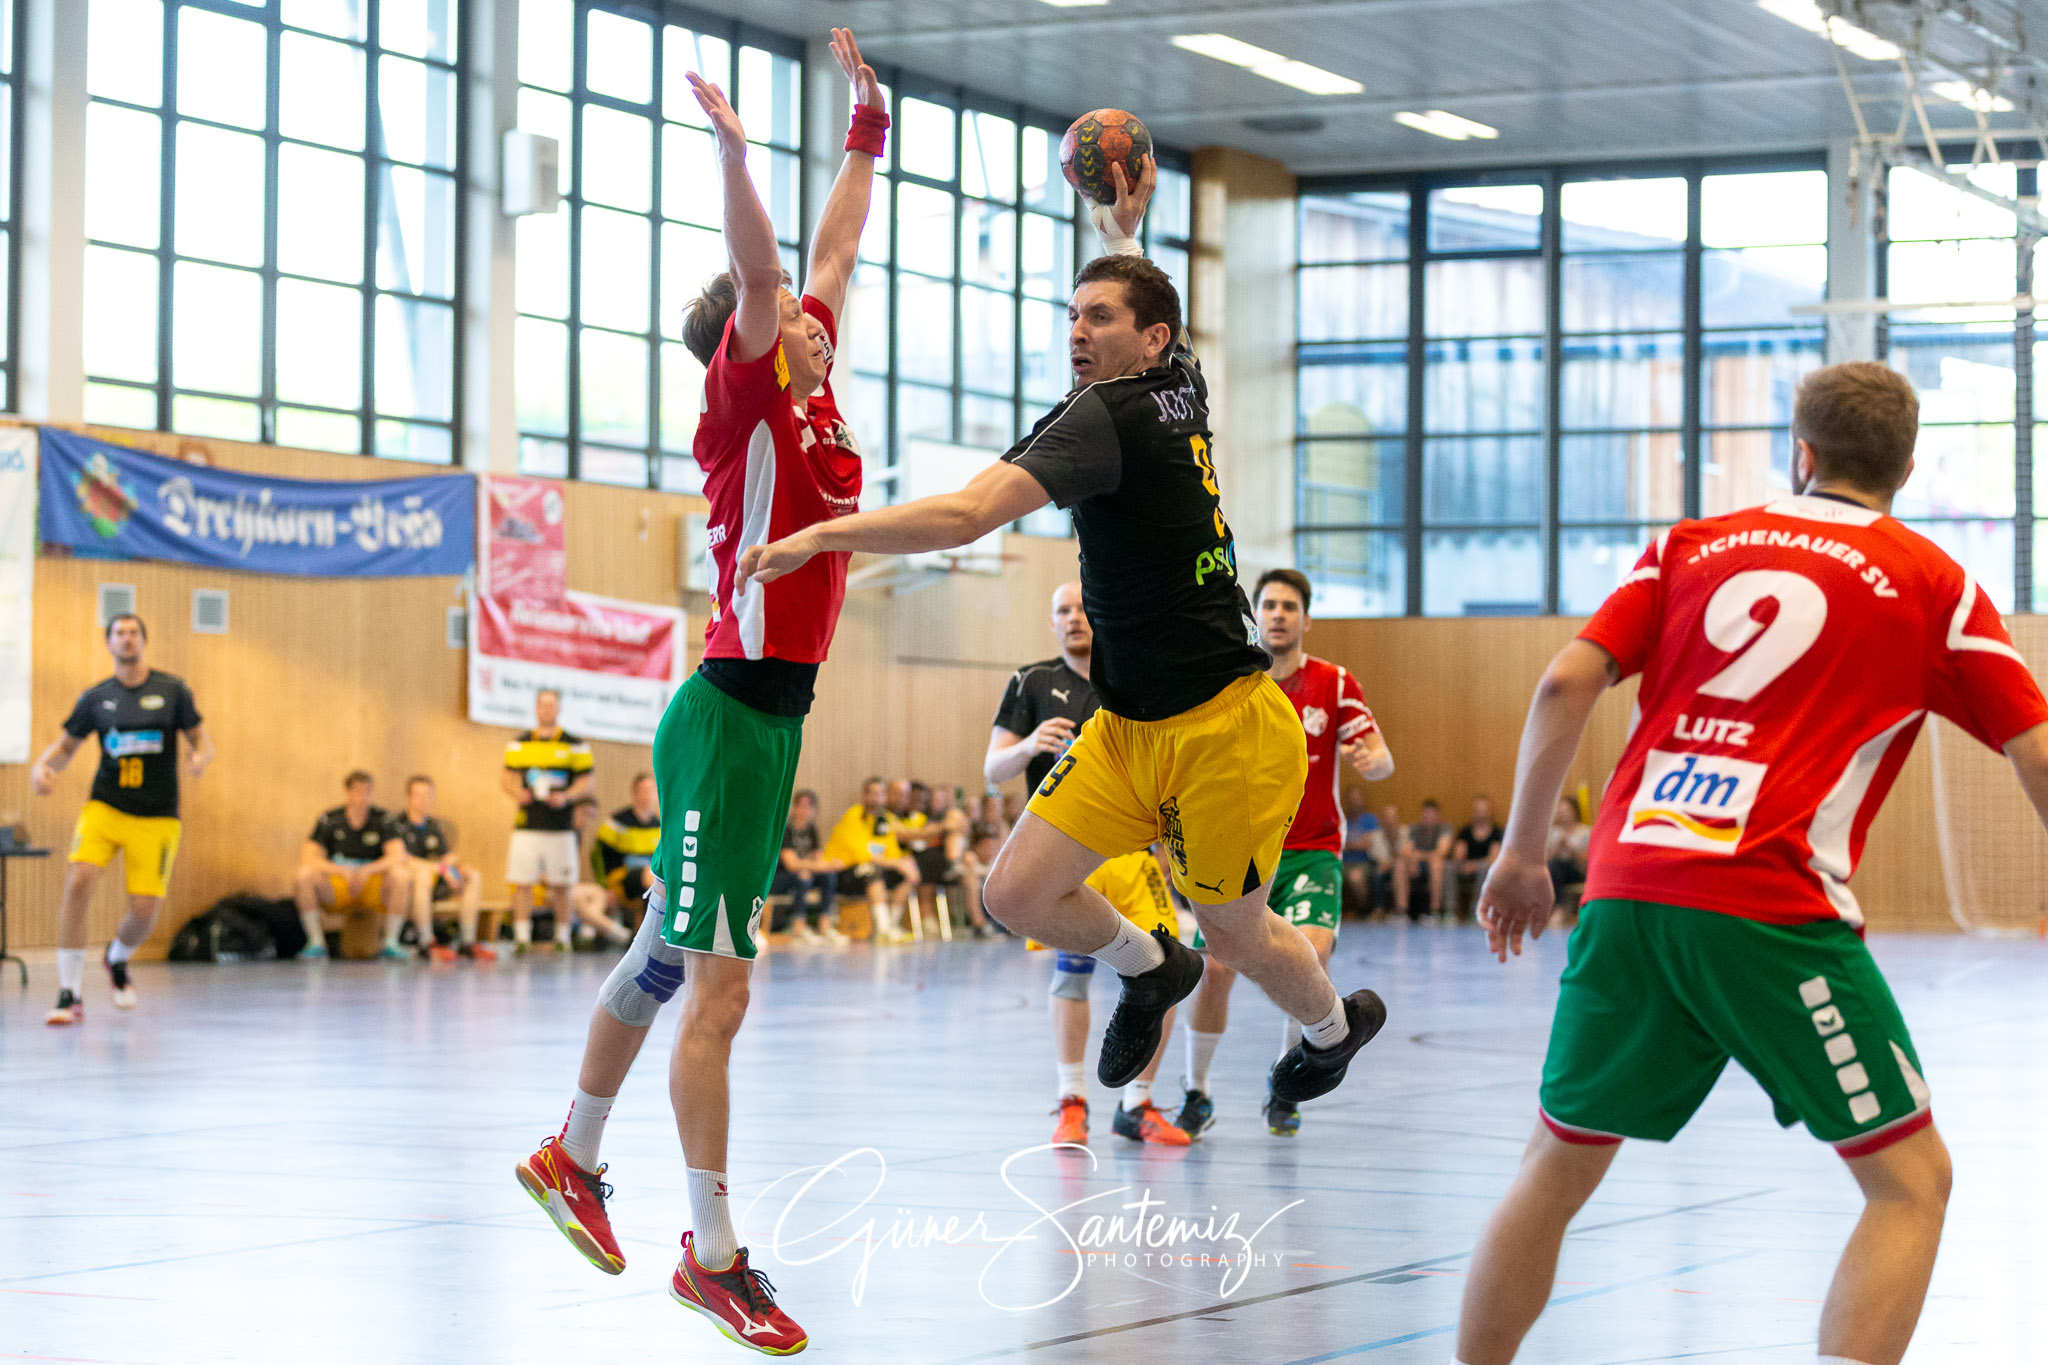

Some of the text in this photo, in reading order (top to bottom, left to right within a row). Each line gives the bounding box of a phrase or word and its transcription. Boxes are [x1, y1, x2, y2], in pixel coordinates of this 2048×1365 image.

[1688, 530, 1899, 599] ICHENAUER SV
[1696, 569, 1828, 701] 9
[1673, 714, 1756, 747] LUTZ
[1653, 756, 1740, 807] dm
